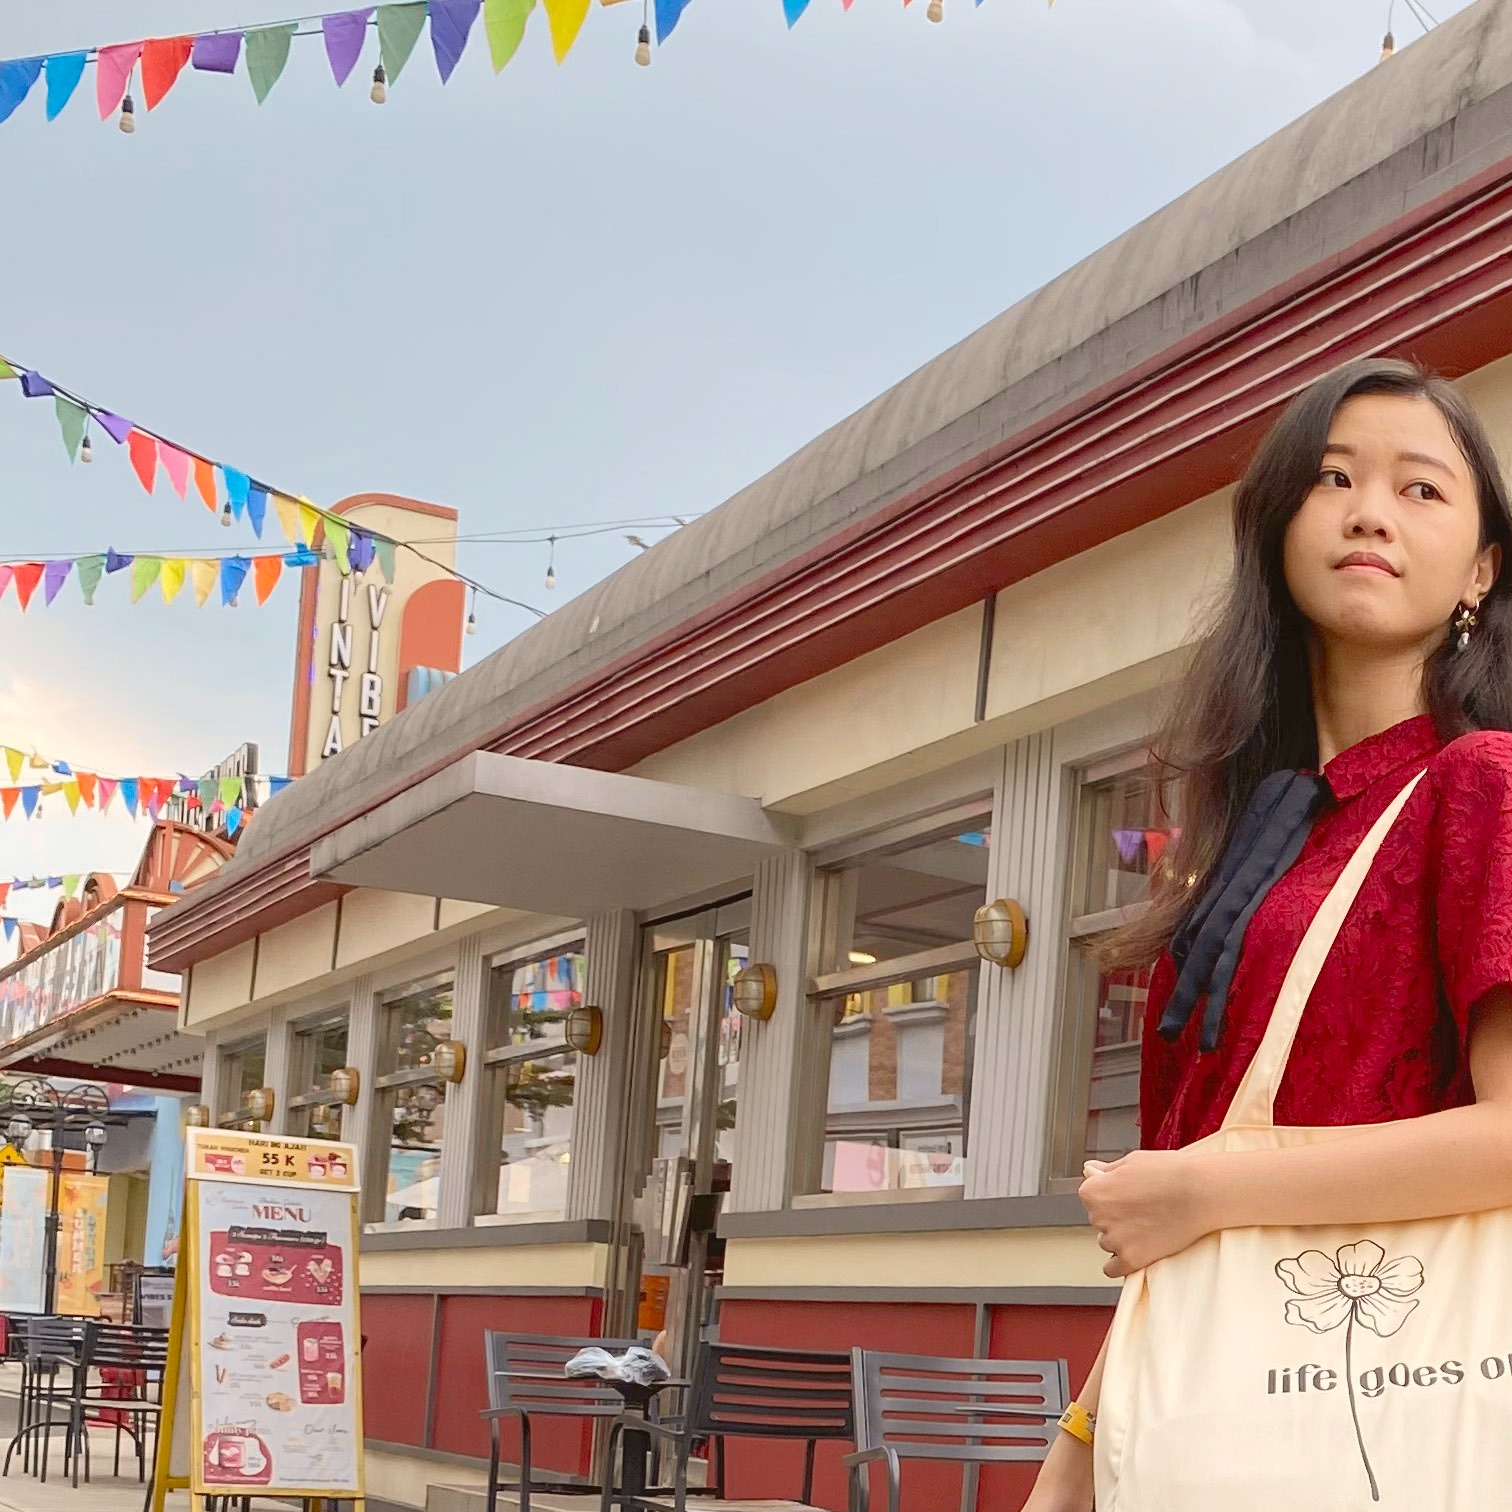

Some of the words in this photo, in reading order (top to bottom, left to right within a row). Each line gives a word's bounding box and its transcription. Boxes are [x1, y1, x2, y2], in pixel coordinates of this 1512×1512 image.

[321, 578, 353, 759] INTA
[360, 584, 390, 738] VIB
[262, 1152, 280, 1165] 55
[285, 1154, 295, 1167] K
[252, 1204, 312, 1223] MENU
[1267, 1363, 1338, 1395] life
[1359, 1360, 1465, 1398] goes
